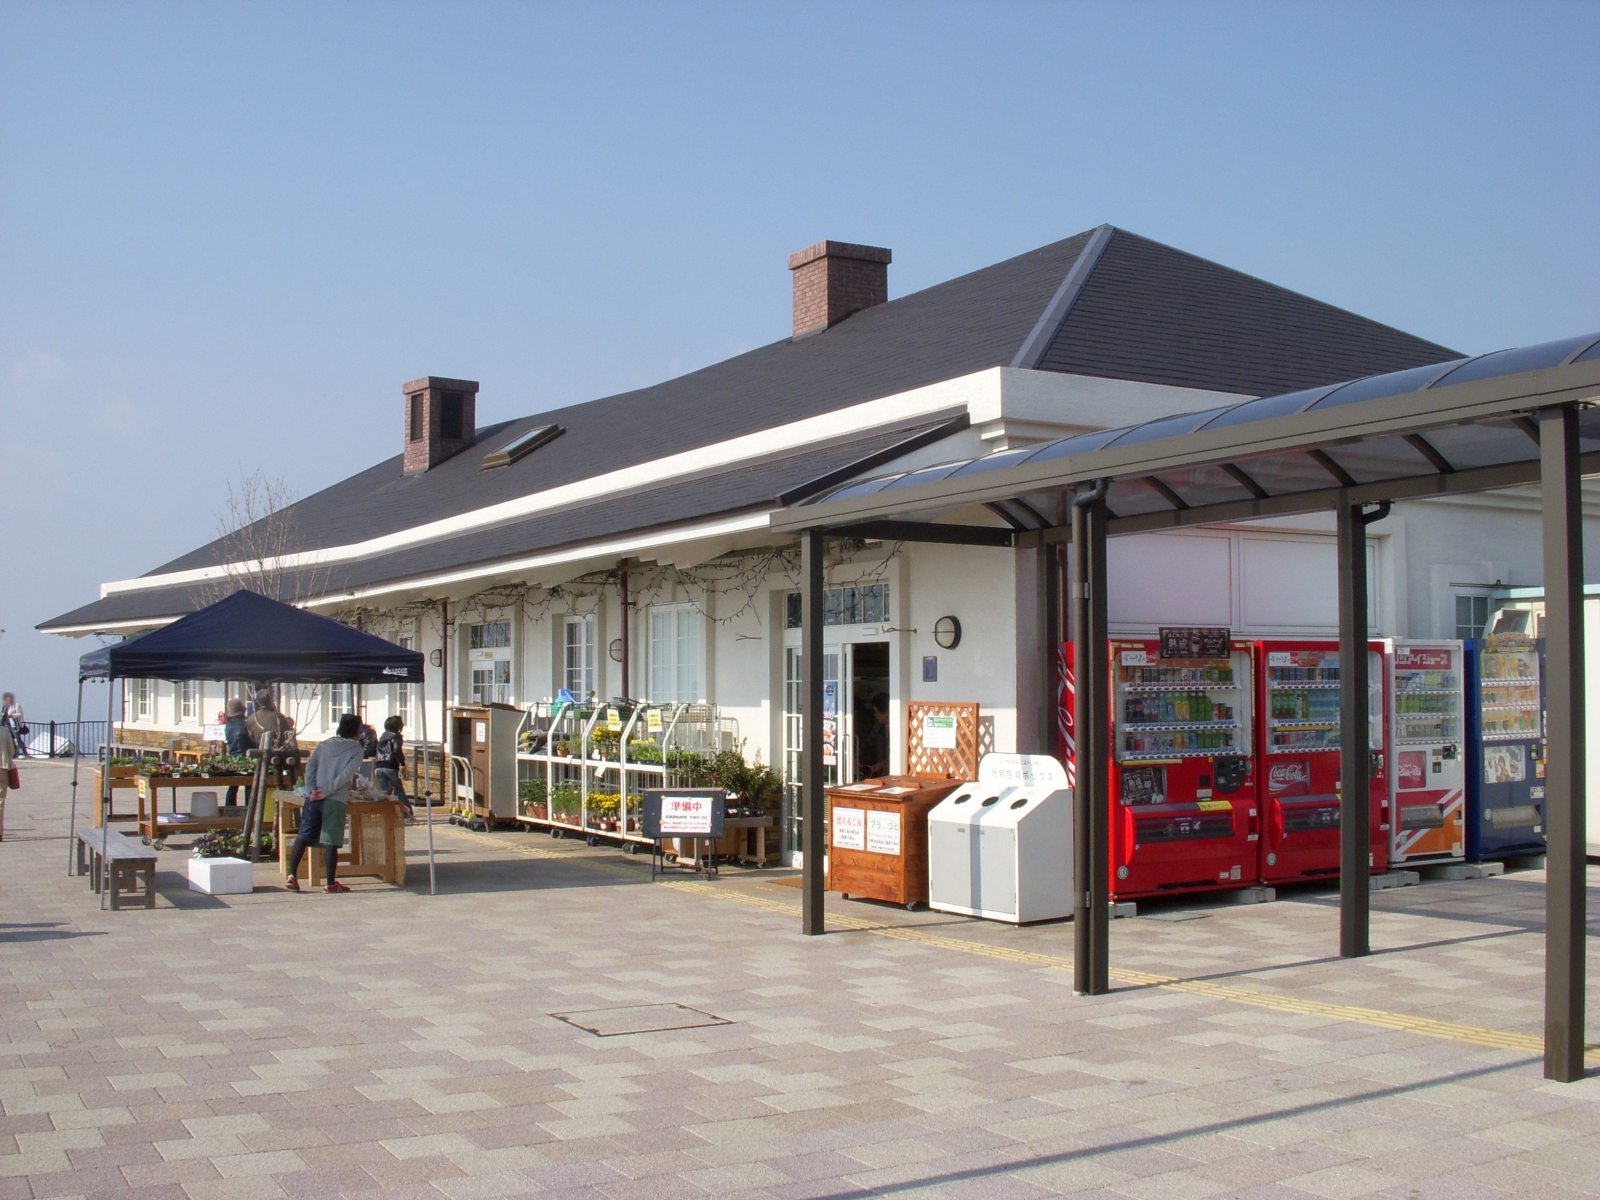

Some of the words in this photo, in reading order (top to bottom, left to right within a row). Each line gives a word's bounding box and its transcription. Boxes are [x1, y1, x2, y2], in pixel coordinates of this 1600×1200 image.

[991, 769, 1054, 781] 分別回収ボックス
[1269, 764, 1305, 782] Coca-Cola
[671, 801, 702, 812] 準備中
[836, 816, 861, 826] 燃えるごみ
